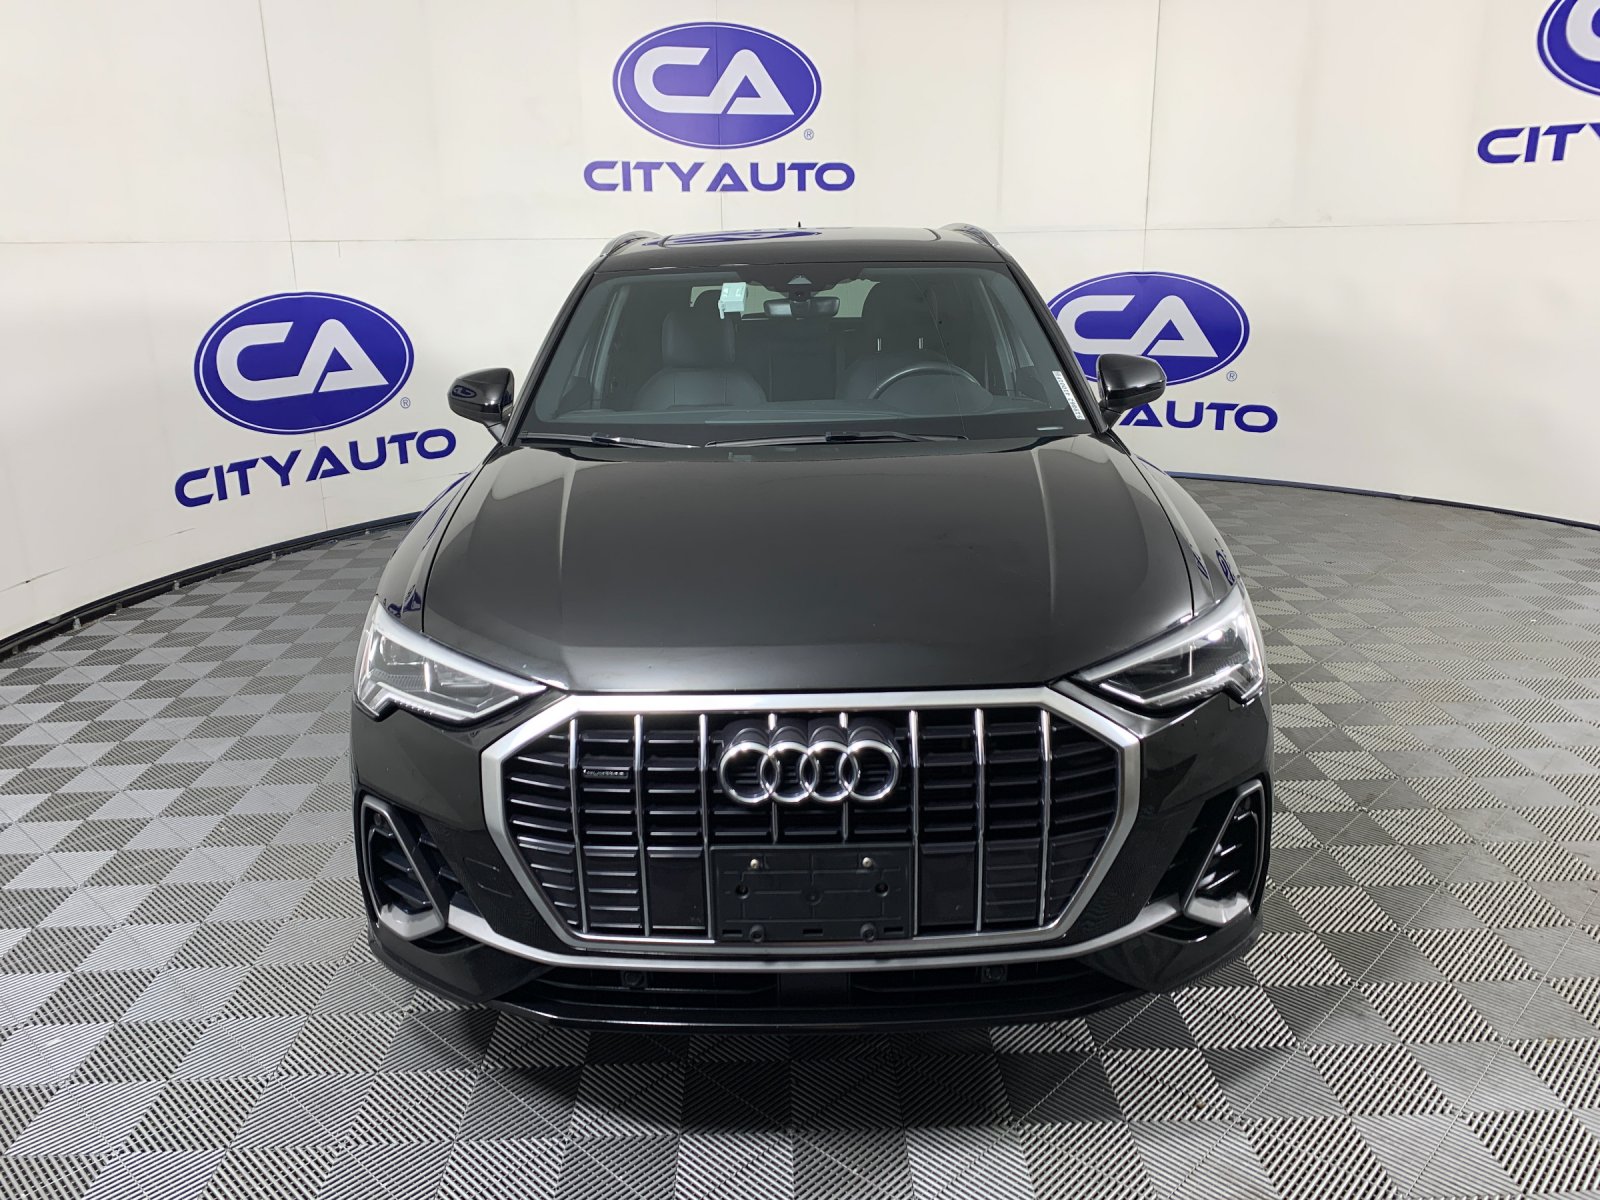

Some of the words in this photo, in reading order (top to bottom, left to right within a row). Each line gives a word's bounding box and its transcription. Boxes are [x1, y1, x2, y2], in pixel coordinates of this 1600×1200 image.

[633, 46, 795, 116] CA
[1056, 294, 1219, 358] CA
[216, 318, 390, 402] CA
[1119, 400, 1279, 433] AUTO
